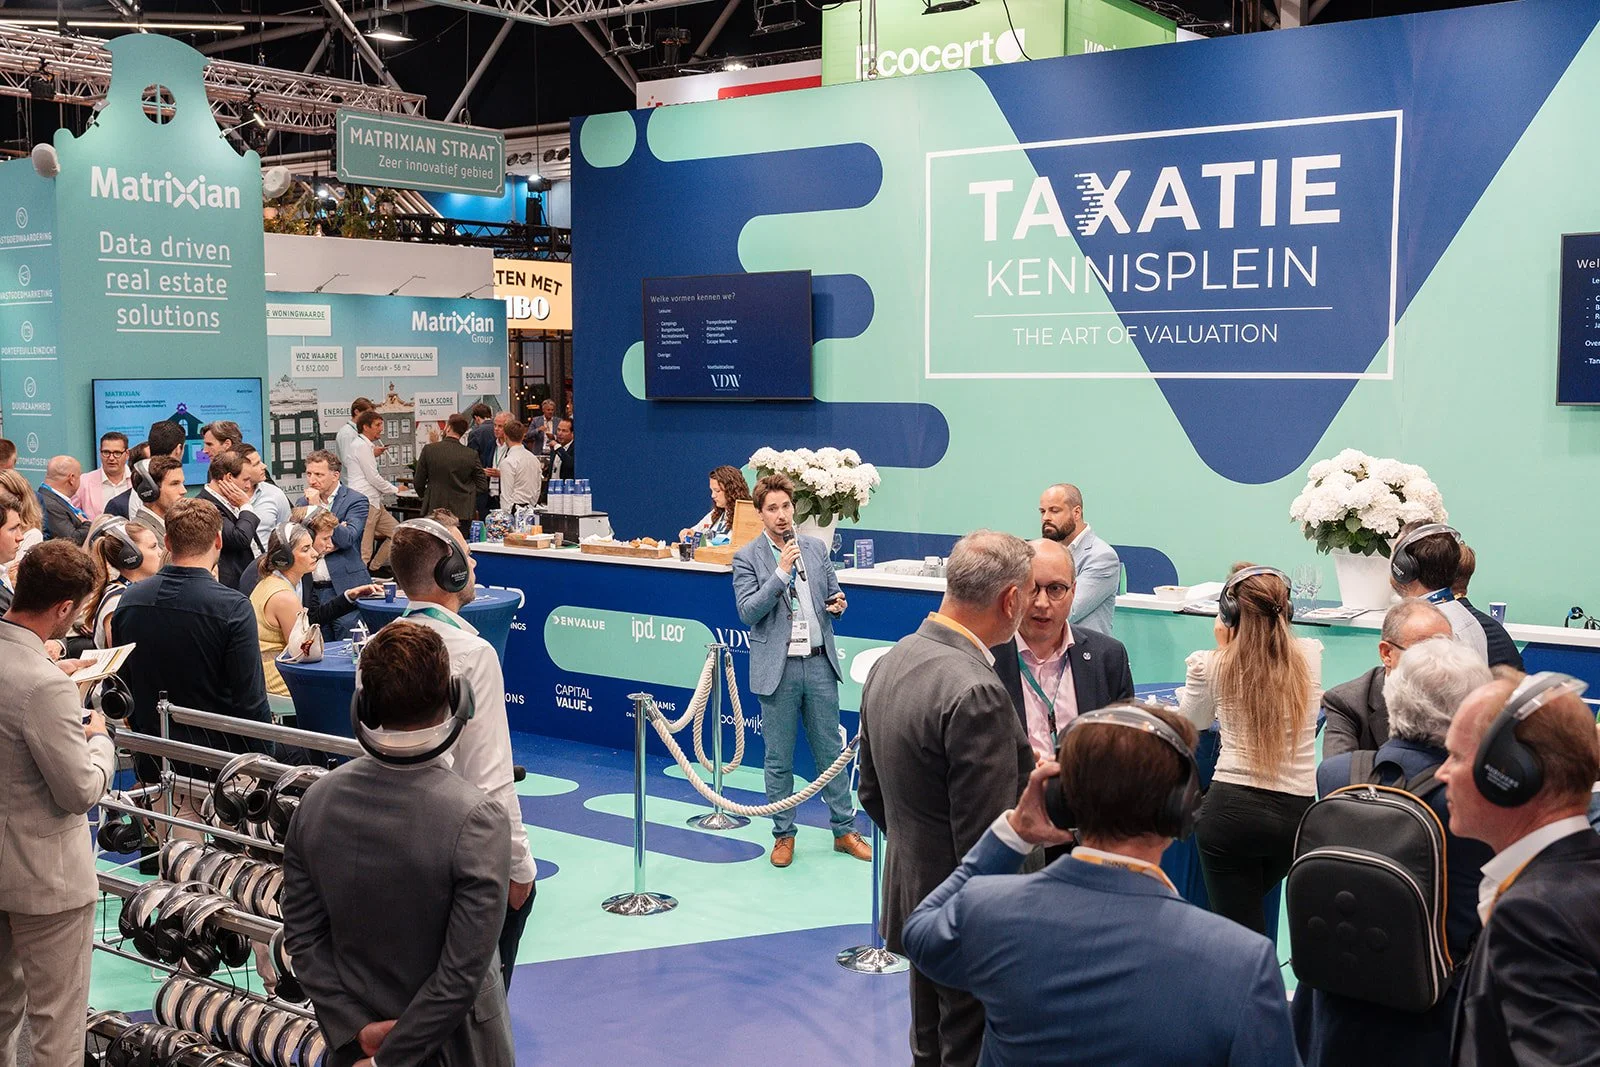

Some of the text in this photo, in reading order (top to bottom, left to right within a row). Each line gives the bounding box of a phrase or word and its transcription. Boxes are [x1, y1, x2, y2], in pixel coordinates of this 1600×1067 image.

[350, 127, 495, 162] MATRIXIAN STRAAT
[379, 155, 493, 180] Zeer innovatief gebied
[91, 166, 241, 210] Matrixian
[968, 154, 1341, 241] TAXATIE
[0, 231, 52, 245] STGOEDWAARDERING
[100, 231, 231, 261] Data driven
[987, 246, 1317, 297] KENNISPLEIN
[1576, 258, 1600, 269] Wel
[106, 268, 228, 294] real estate
[496, 270, 563, 296] TEN MET
[650, 295, 669, 303] Welke
[697, 293, 721, 301] kennen
[722, 292, 736, 300] we?
[117, 303, 220, 328] solutions
[272, 310, 325, 318] WONINGWAARDE
[412, 311, 494, 334] Matrixian
[471, 333, 494, 344] Group
[1013, 323, 1278, 346] THE ART OF VALUATION
[391, 352, 433, 360] DAKINVULLING
[710, 374, 741, 387] VDW
[280, 485, 304, 493] VLAKTE
[561, 616, 606, 630] ENVALUE
[631, 616, 656, 643] ipd
[505, 692, 525, 704] ONS
[555, 683, 593, 700] CAPITAL
